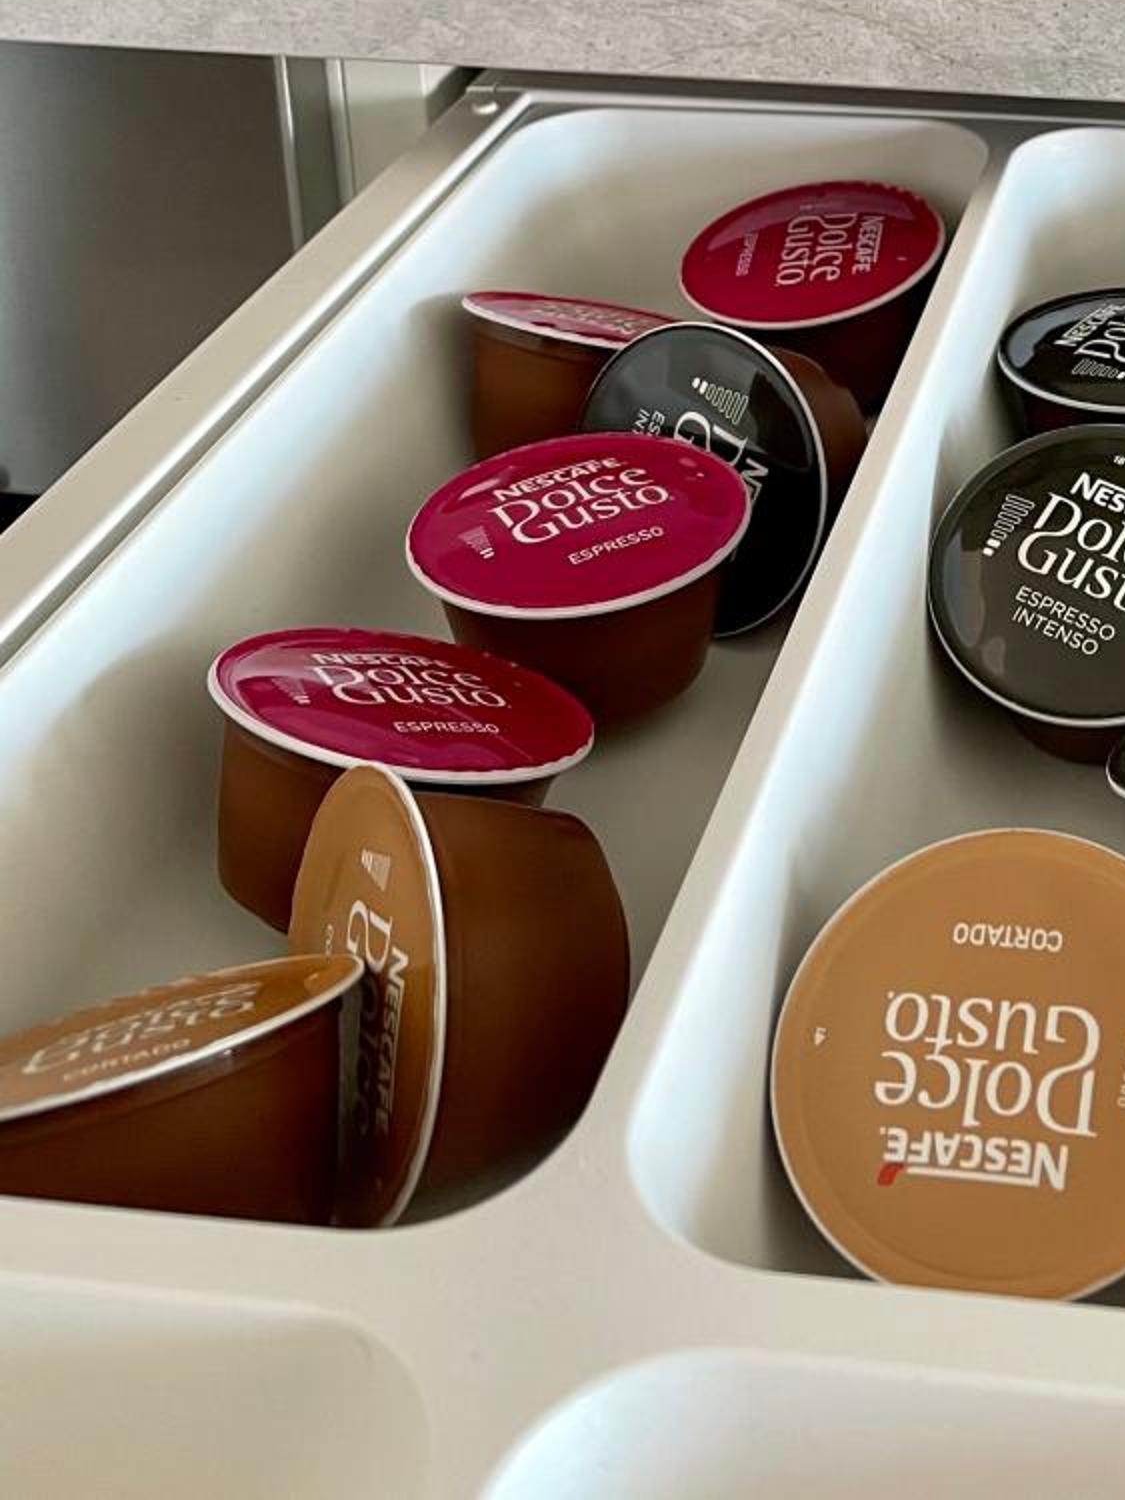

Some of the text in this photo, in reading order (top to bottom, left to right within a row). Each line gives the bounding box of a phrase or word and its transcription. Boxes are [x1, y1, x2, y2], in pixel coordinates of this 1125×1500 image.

[776, 215, 818, 285] Gusto
[810, 213, 859, 281] Dolce
[487, 467, 654, 528] Dolce
[511, 484, 670, 544] Gusto
[568, 525, 664, 564] ESPRESSO
[1012, 607, 1099, 656] INTENSO
[1015, 585, 1116, 642] ESPRESSO
[308, 665, 484, 690] Dolce
[333, 678, 508, 708] Gusto
[394, 720, 500, 734] ESPRESSO
[952, 923, 1063, 952] CORTADO
[885, 991, 1100, 1070] Gusto
[873, 1050, 1098, 1137] Dolce
